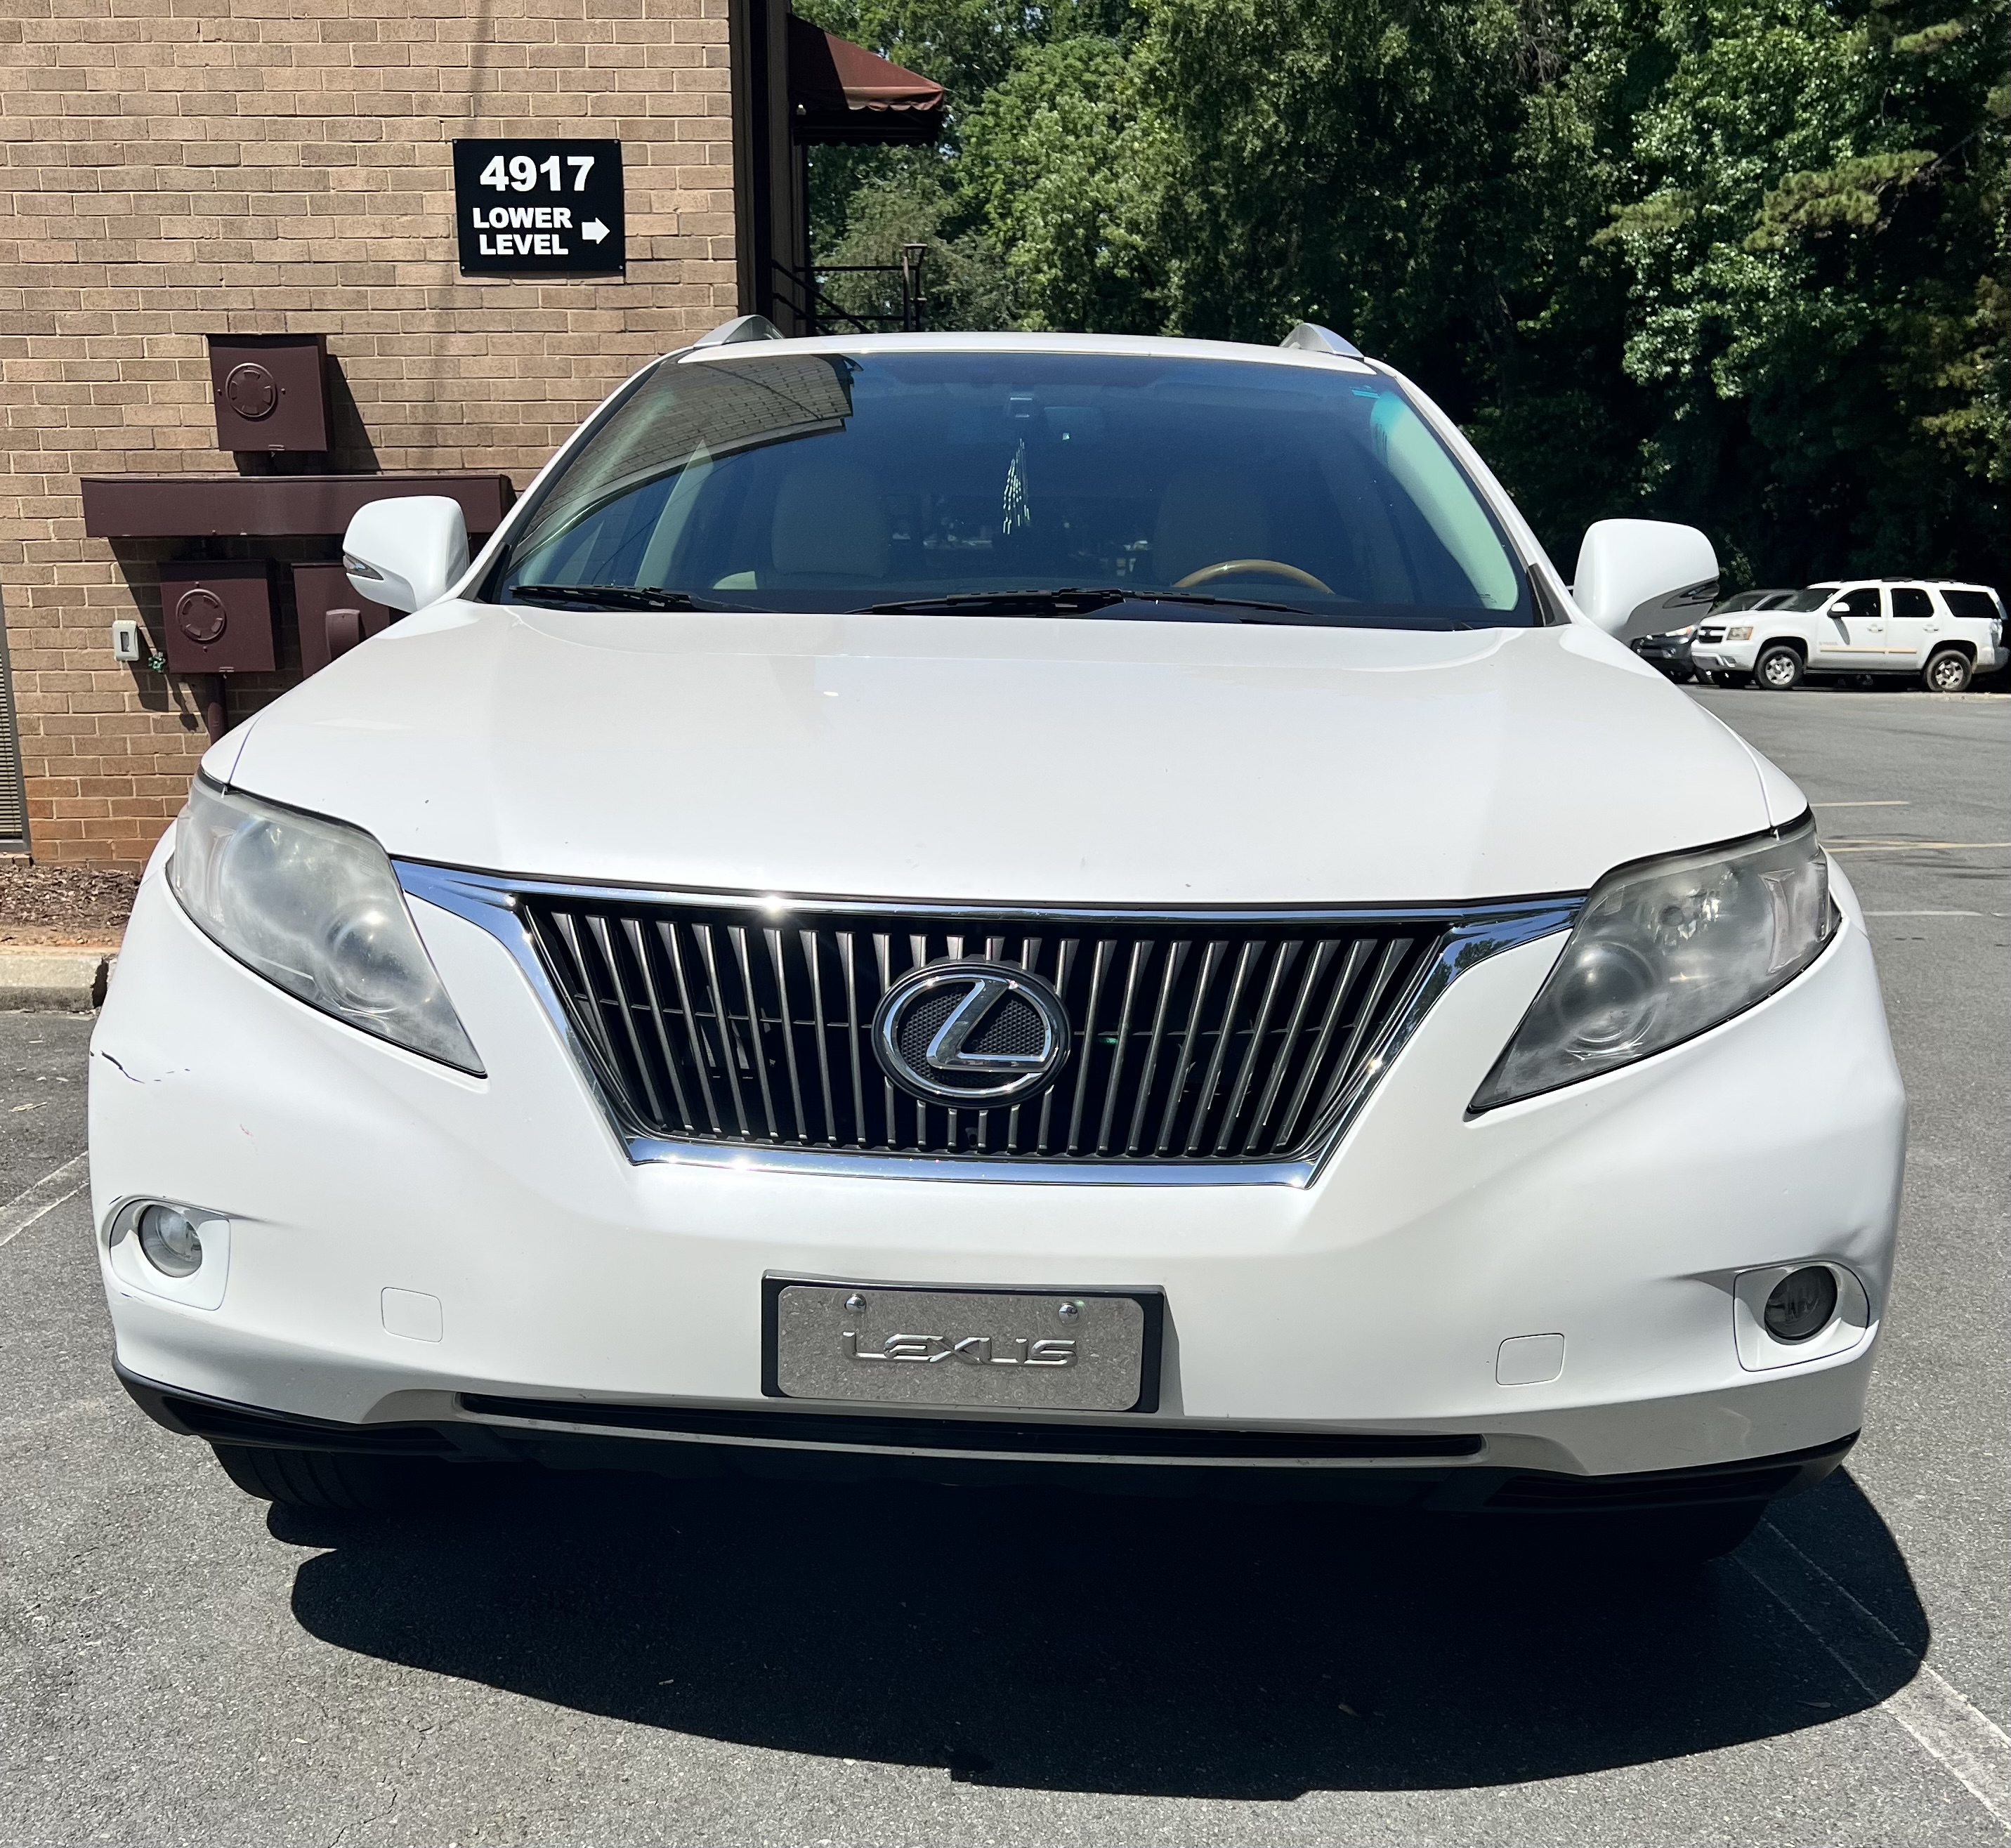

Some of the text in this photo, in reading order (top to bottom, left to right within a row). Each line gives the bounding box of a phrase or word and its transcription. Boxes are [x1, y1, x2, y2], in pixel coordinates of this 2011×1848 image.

[480, 155, 595, 192] 4917
[473, 207, 573, 229] LOWER
[479, 234, 569, 256] LEVEL
[843, 1330, 1077, 1368] LEXUS
